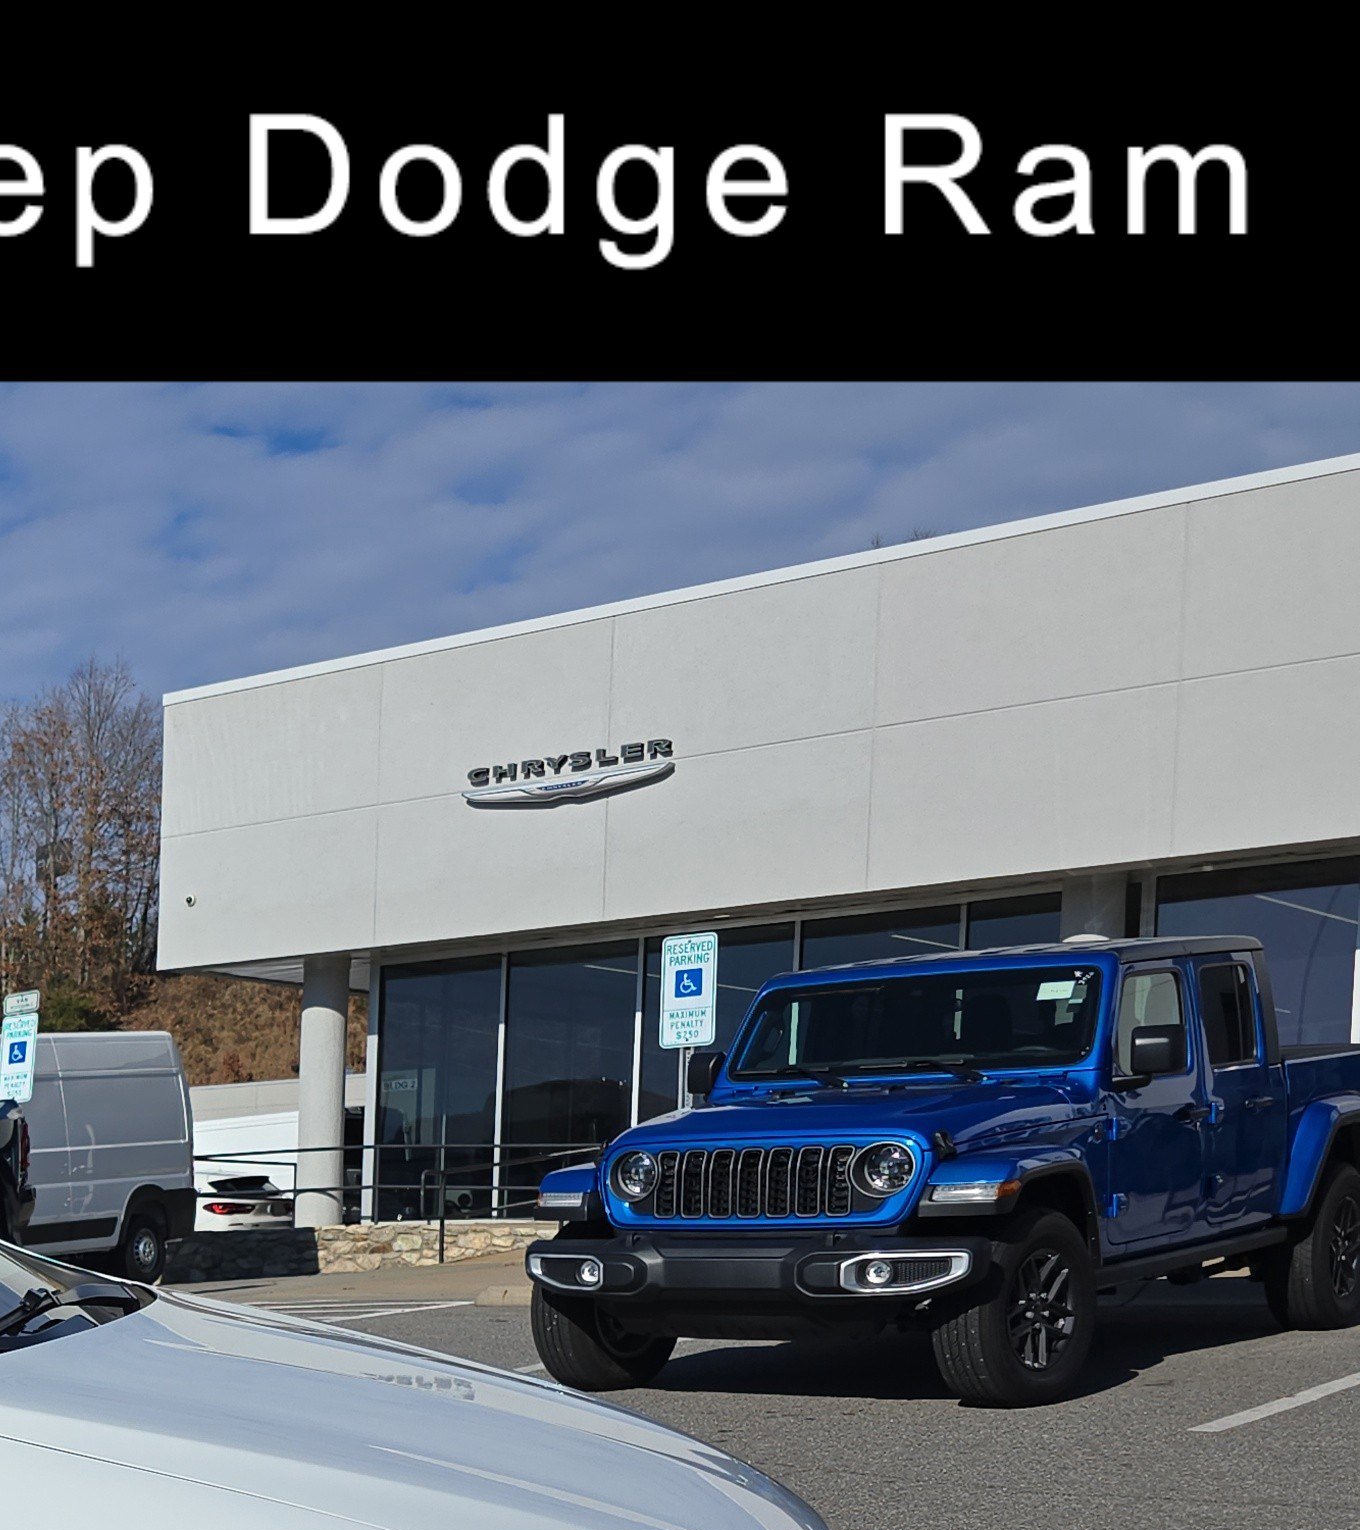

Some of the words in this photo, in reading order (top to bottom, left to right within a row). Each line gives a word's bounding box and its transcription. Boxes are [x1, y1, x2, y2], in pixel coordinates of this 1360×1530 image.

[466, 738, 674, 788] CHRYSLER
[666, 940, 713, 956] RESERVED
[669, 952, 710, 967] PARKING
[669, 1009, 707, 1020] MAXIMUM
[670, 1019, 704, 1030] PENALTY
